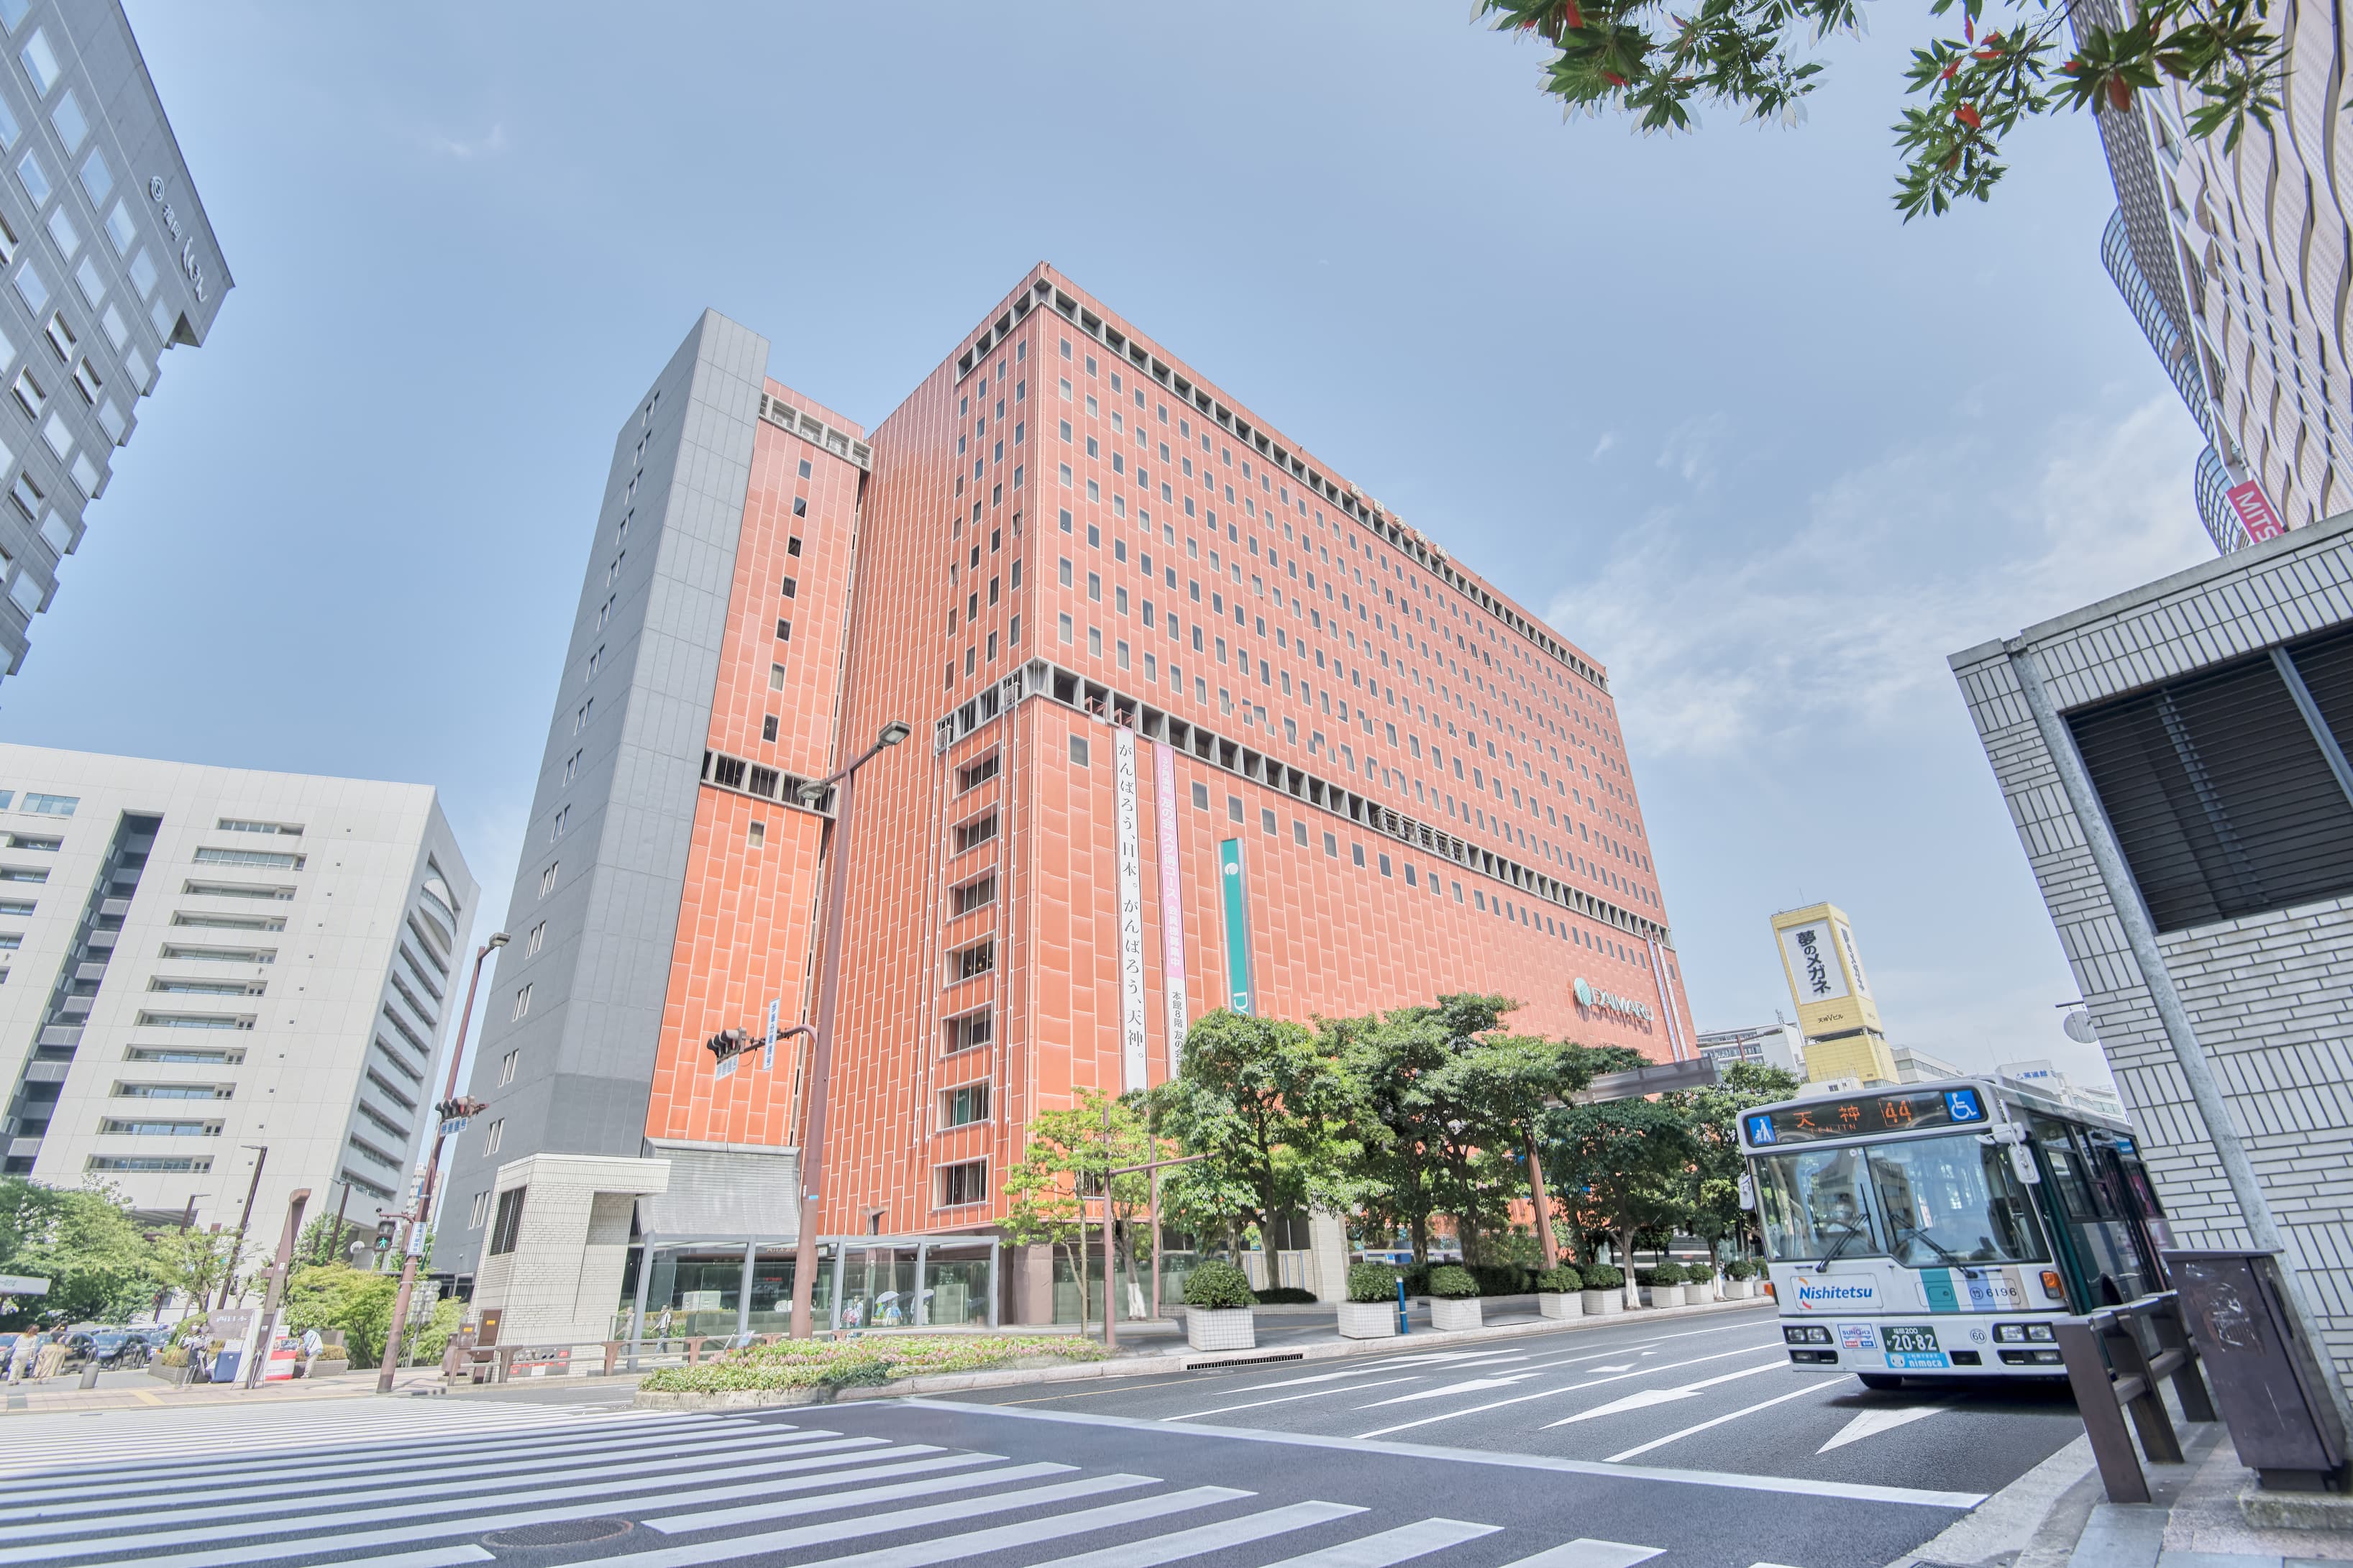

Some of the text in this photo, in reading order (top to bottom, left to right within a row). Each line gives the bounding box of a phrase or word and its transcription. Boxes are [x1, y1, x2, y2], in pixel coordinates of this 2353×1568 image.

[2236, 490, 2278, 541] MITS
[1796, 930, 1831, 994] 夢のメガネ
[1172, 991, 1183, 1028] 本館8階
[1591, 986, 1654, 1022] DAIMARU
[1818, 1014, 1844, 1024] 天神Vビル
[1885, 1101, 1911, 1124] 44
[1799, 1285, 1873, 1300] Nishitetsu
[1986, 1288, 2017, 1297] 6196
[1891, 1334, 1937, 1352] 20-82
[1909, 1358, 1942, 1368] nimoca
